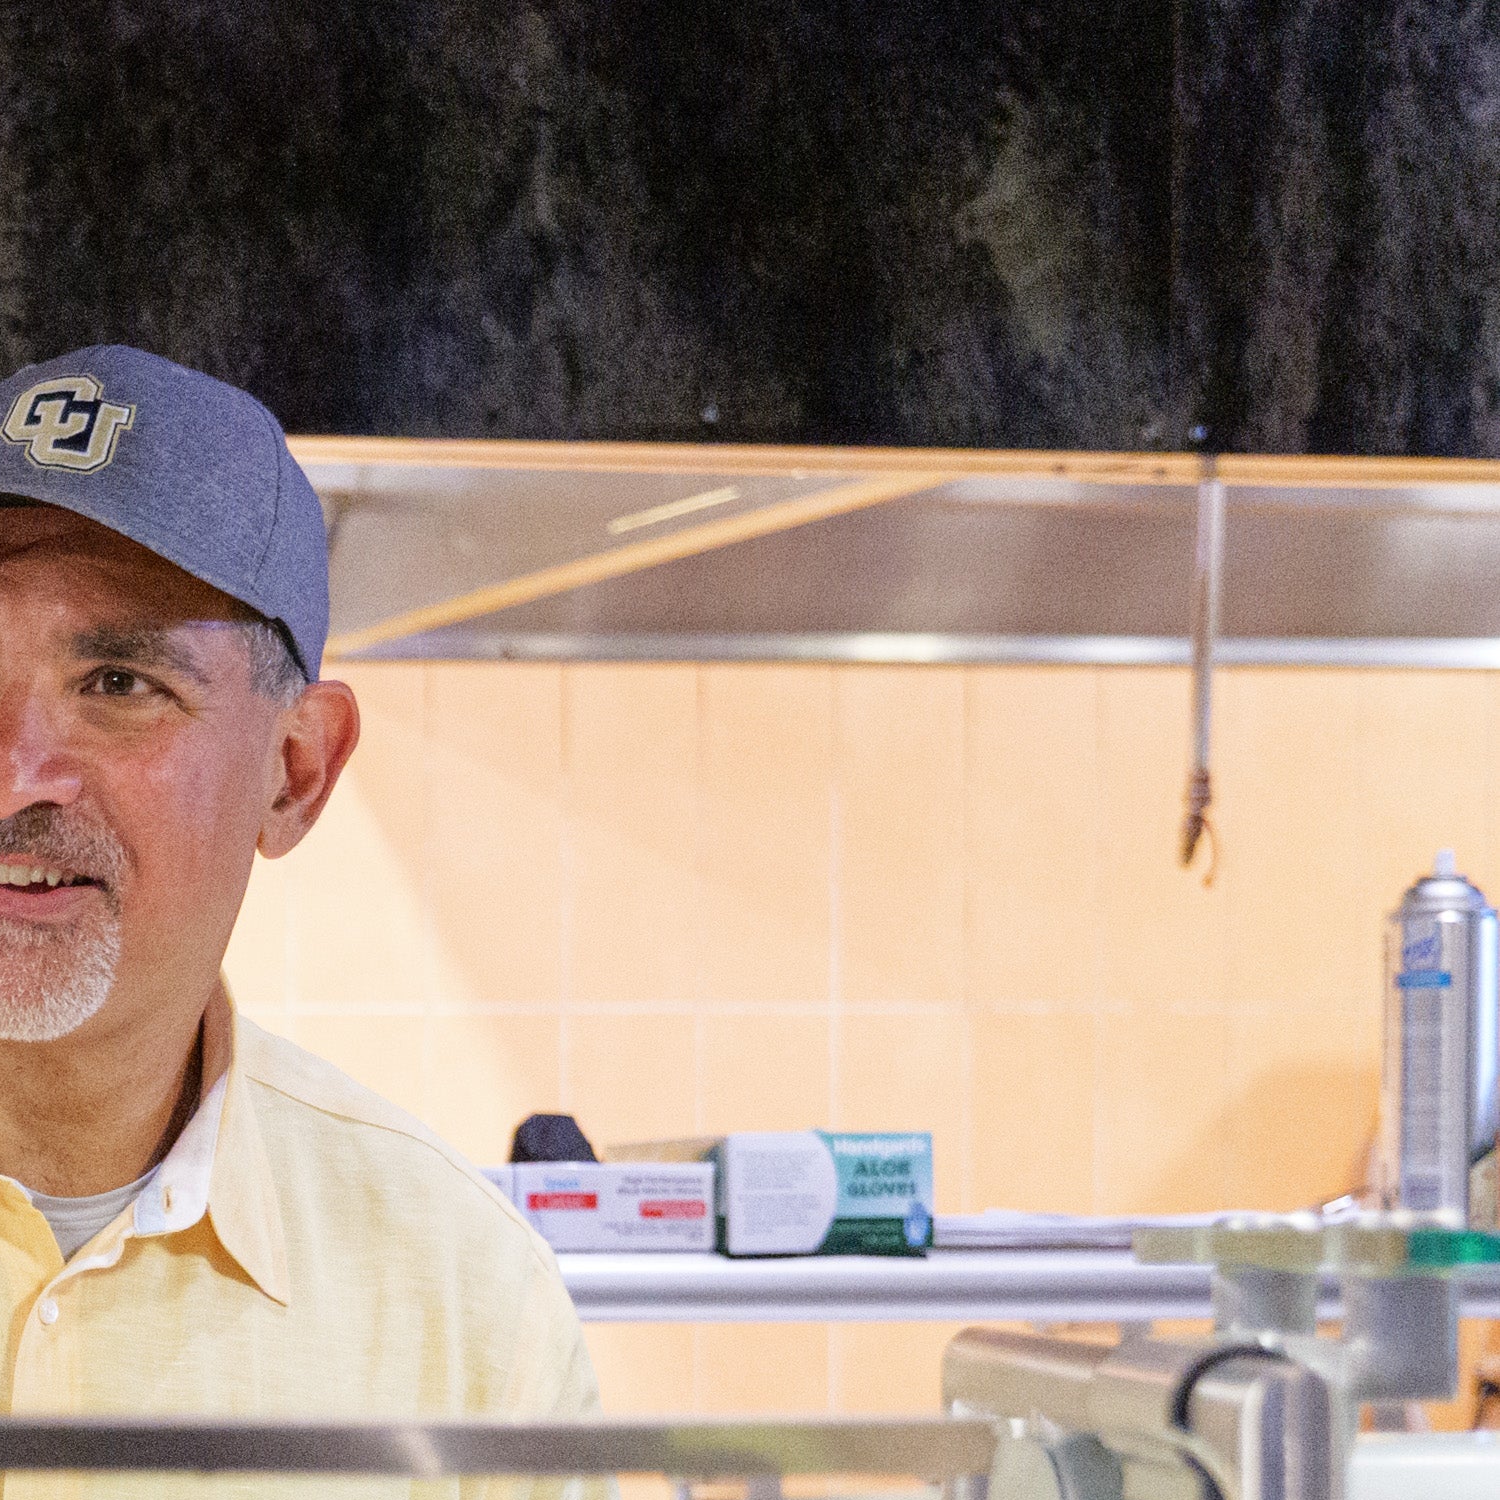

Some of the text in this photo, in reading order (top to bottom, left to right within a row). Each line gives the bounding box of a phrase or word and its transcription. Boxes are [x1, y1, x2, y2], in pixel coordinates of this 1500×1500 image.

[1, 374, 136, 475] CU
[854, 1159, 911, 1177] ALOE
[847, 1180, 917, 1198] GLOVES
